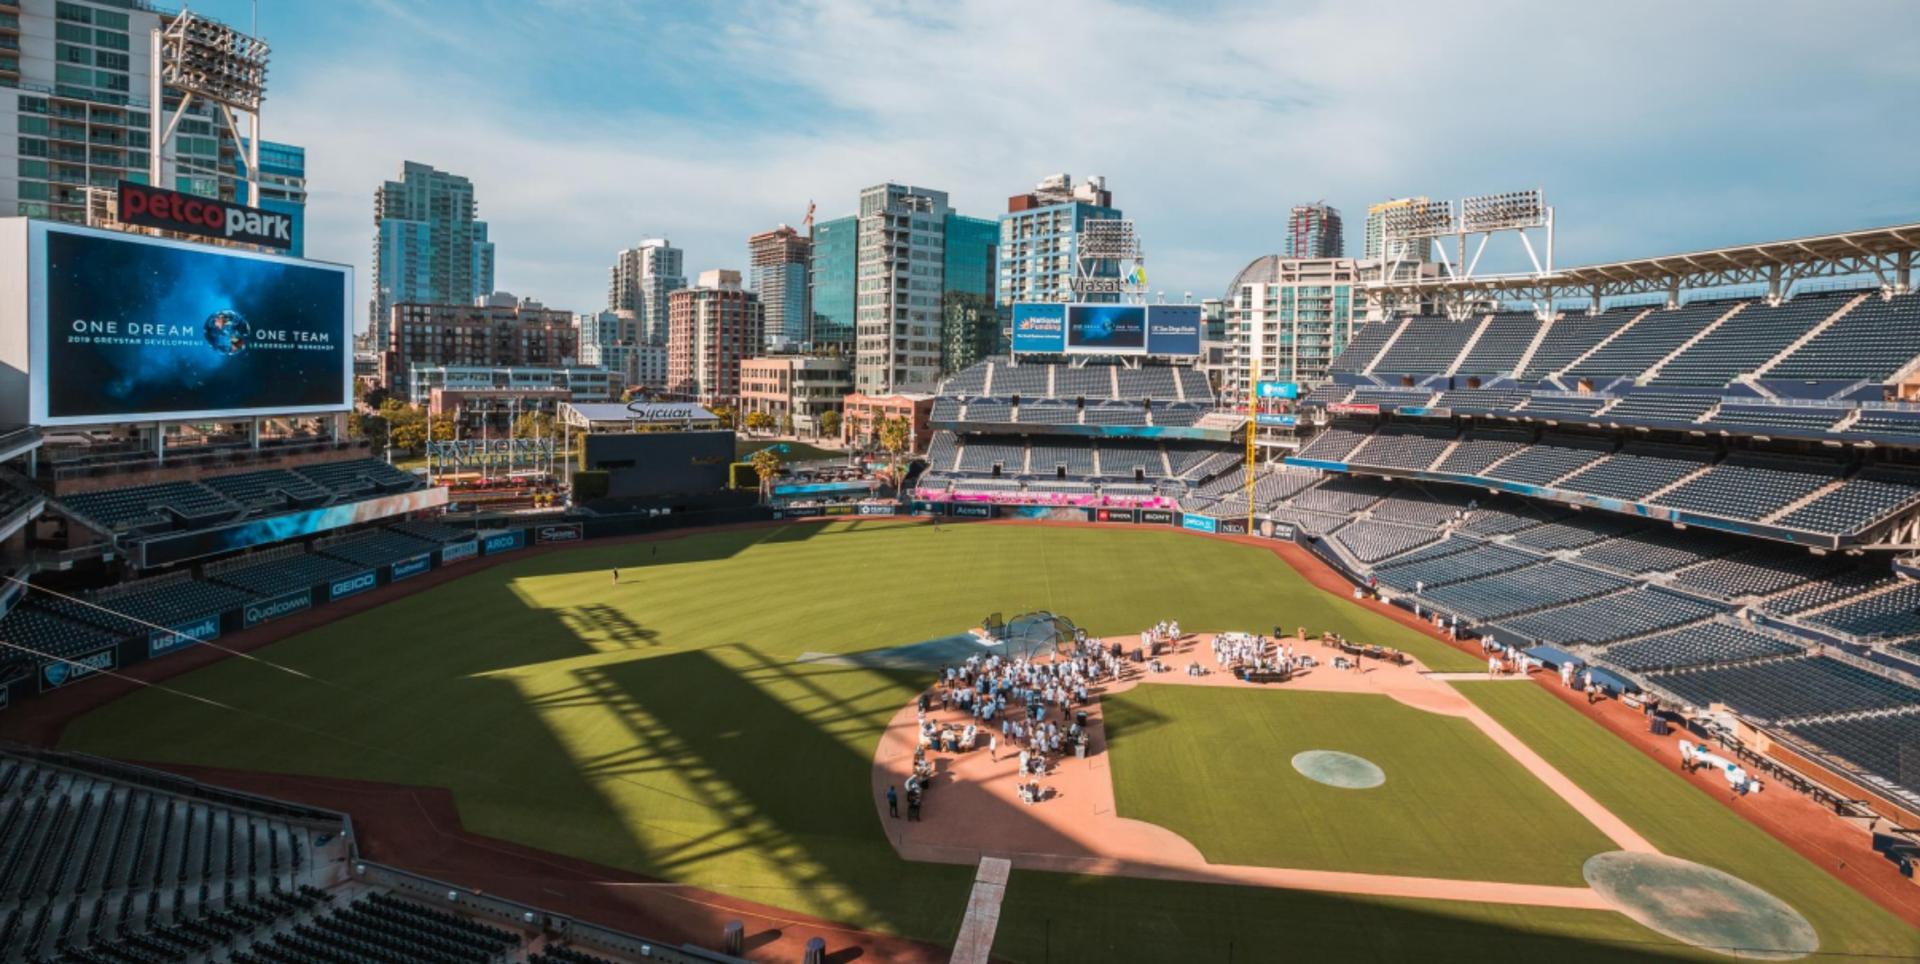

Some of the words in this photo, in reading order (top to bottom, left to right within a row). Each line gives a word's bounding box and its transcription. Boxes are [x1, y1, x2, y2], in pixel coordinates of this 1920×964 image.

[1069, 277, 1123, 292] Viasat
[1030, 316, 1061, 324] National
[1030, 323, 1061, 332] Funding
[72, 319, 118, 334] ONE
[127, 322, 195, 337] DREAM
[255, 329, 287, 341] ONE
[292, 331, 329, 343] TEAM
[93, 336, 142, 345] GREYSTAR
[144, 338, 203, 347] DEVELOPMENT
[626, 399, 693, 422] Sycuan
[486, 538, 514, 551] ARCO
[332, 574, 375, 596] GEICO
[246, 597, 309, 622] Qualcomm
